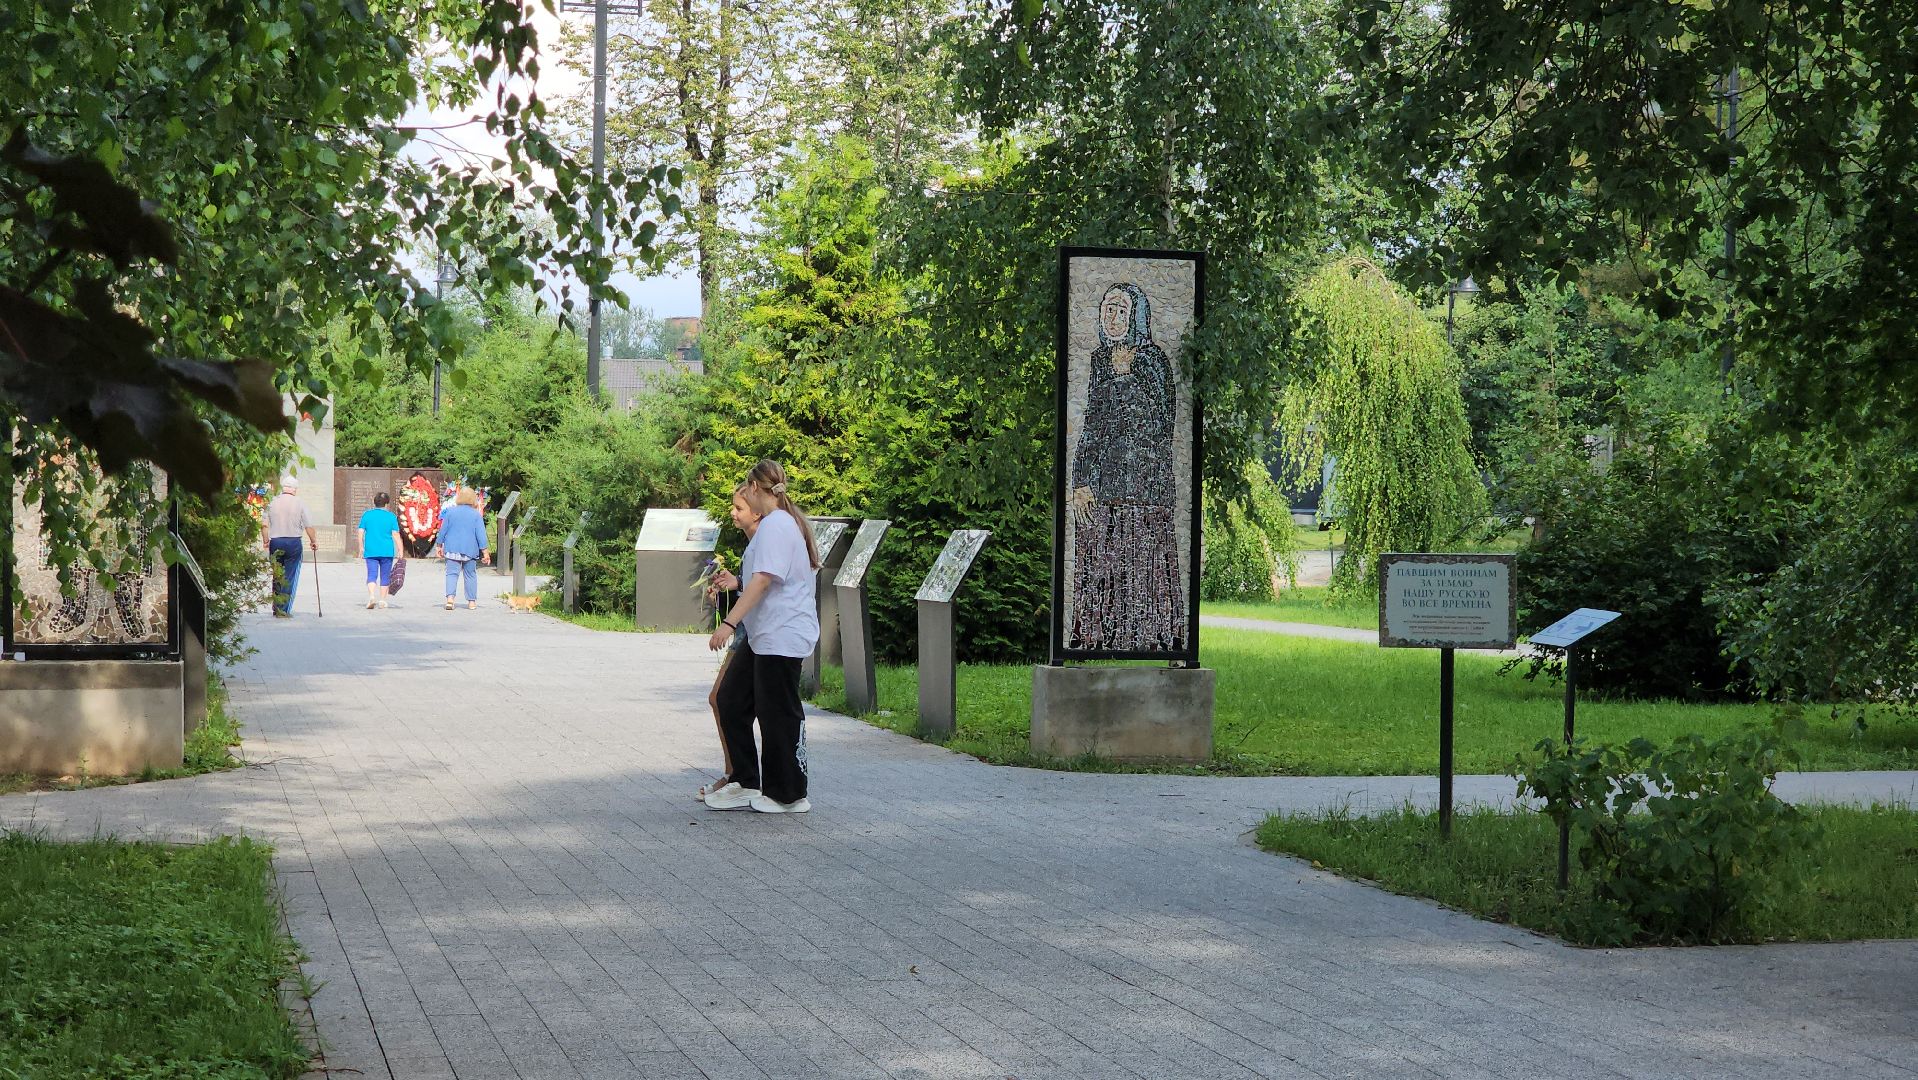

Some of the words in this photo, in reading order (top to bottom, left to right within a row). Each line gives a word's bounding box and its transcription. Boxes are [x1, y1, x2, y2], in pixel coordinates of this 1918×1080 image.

[1397, 568, 1446, 577] ПАВШИМ
[1450, 569, 1497, 578] ВОИНАМ
[1421, 580, 1432, 588] ЗА
[1403, 589, 1434, 598] НАШУ
[1439, 589, 1490, 598] РУССКУЮ
[1402, 599, 1416, 607] ВО
[1419, 599, 1439, 608] ВСЕ
[1442, 600, 1492, 609] ВРЕМЕНА
